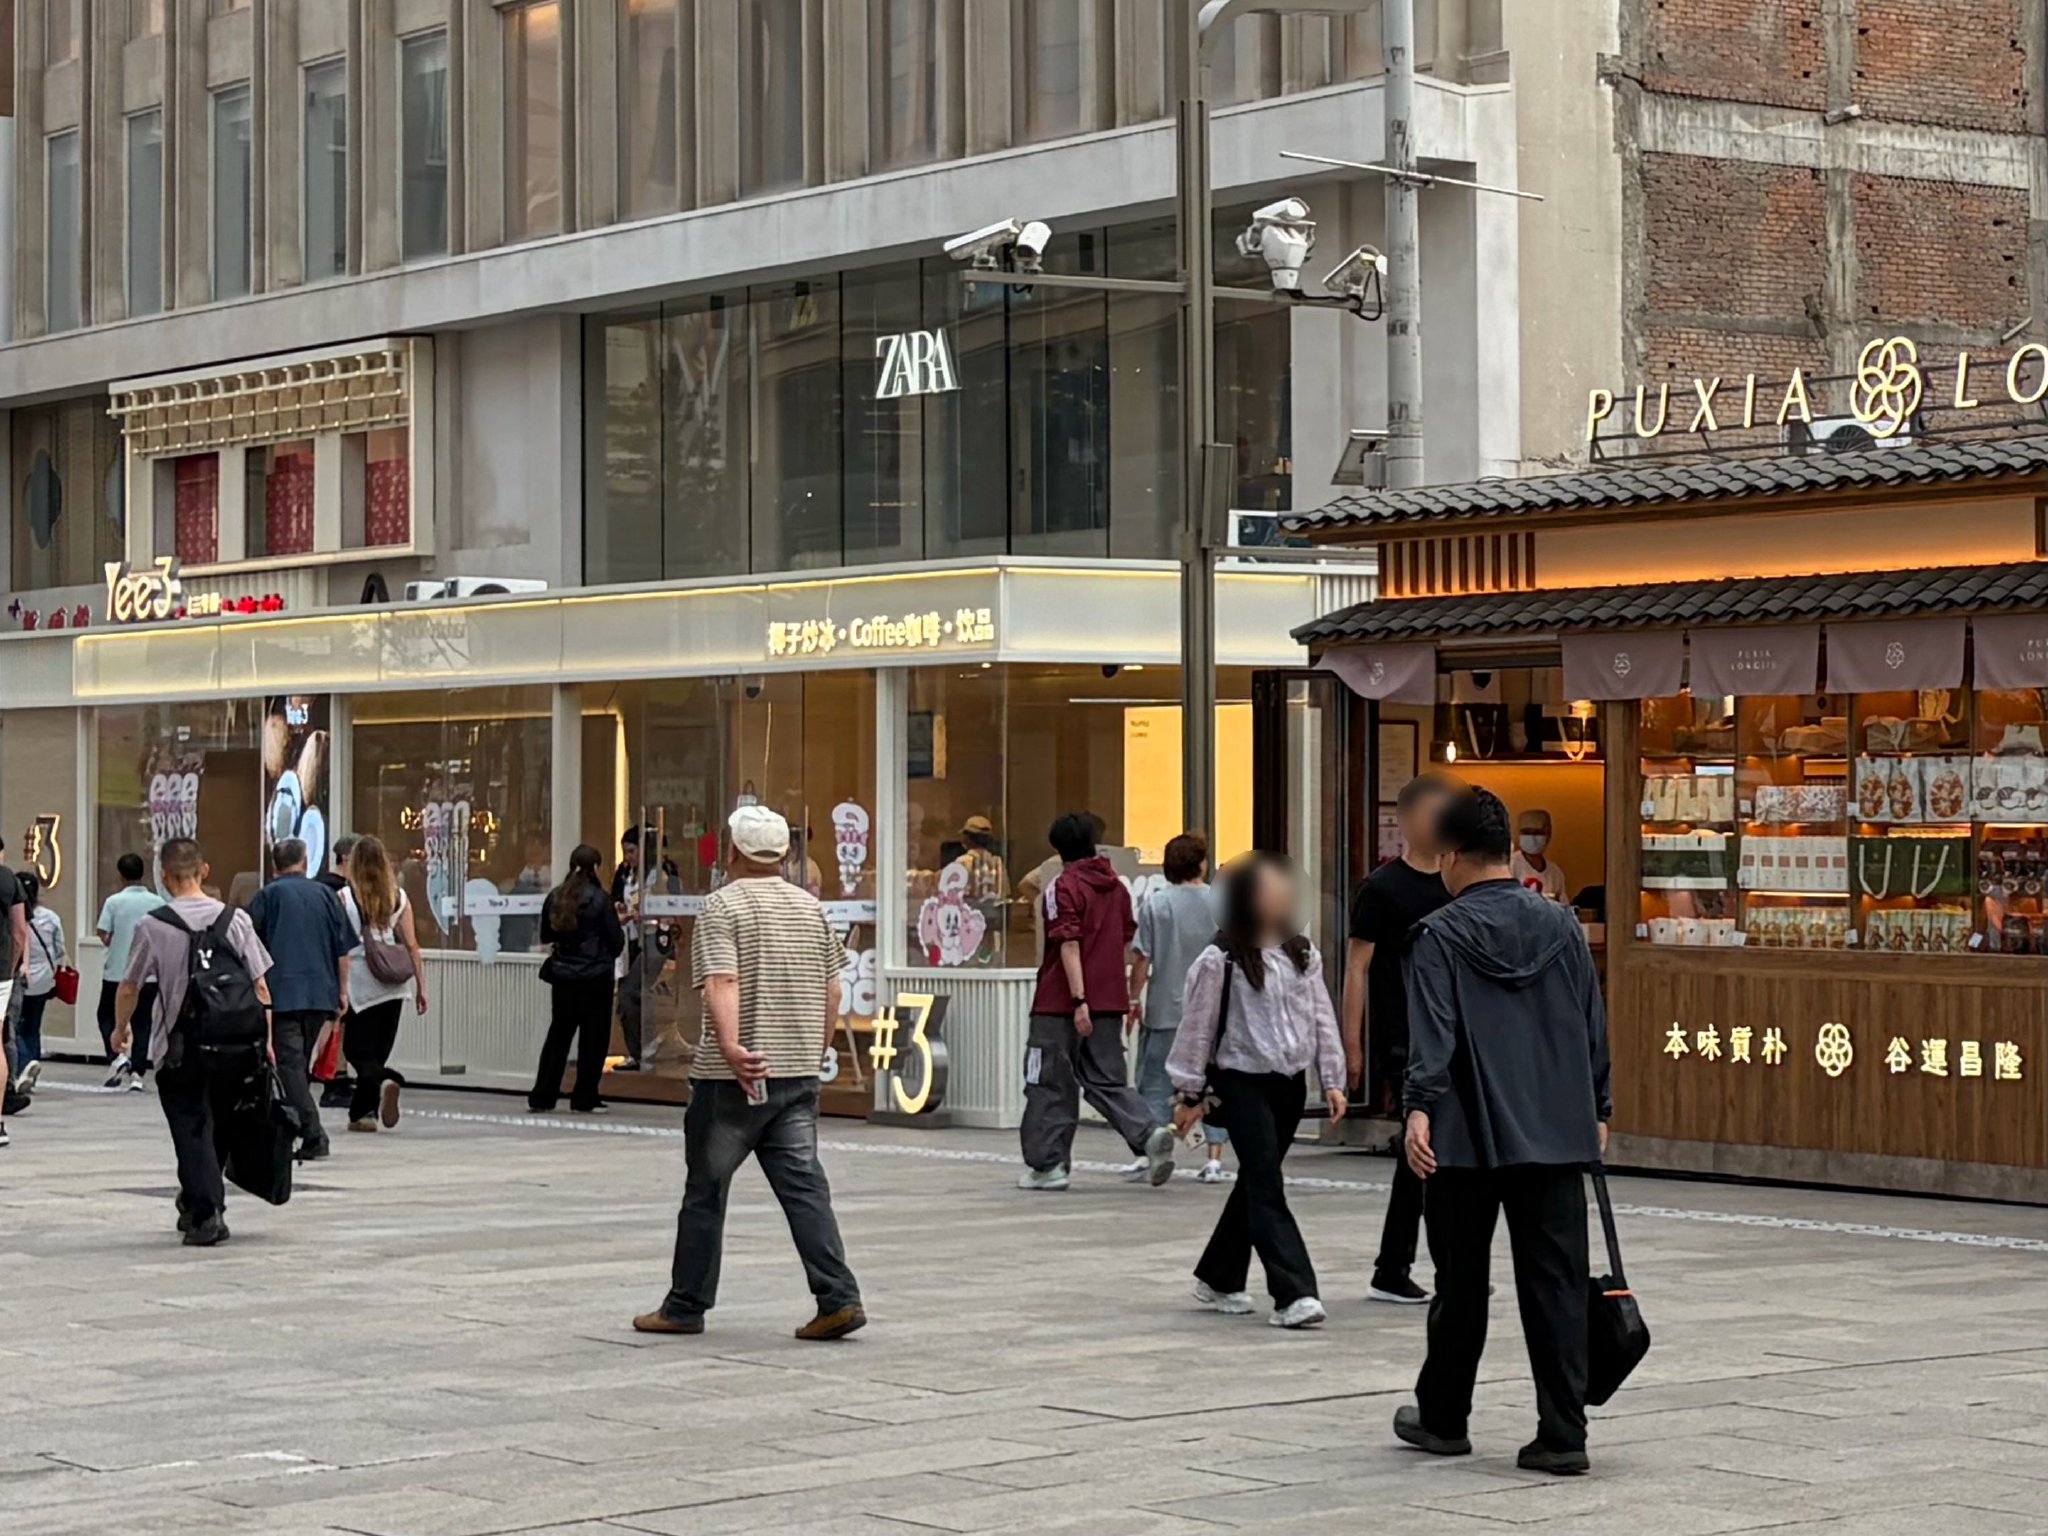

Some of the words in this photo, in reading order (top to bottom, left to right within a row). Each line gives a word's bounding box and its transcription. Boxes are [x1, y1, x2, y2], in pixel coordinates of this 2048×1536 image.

[876, 327, 961, 399] ZARA
[1586, 366, 1812, 441] PUXIA
[104, 556, 173, 621] Yee3
[869, 992, 933, 1114] #3
